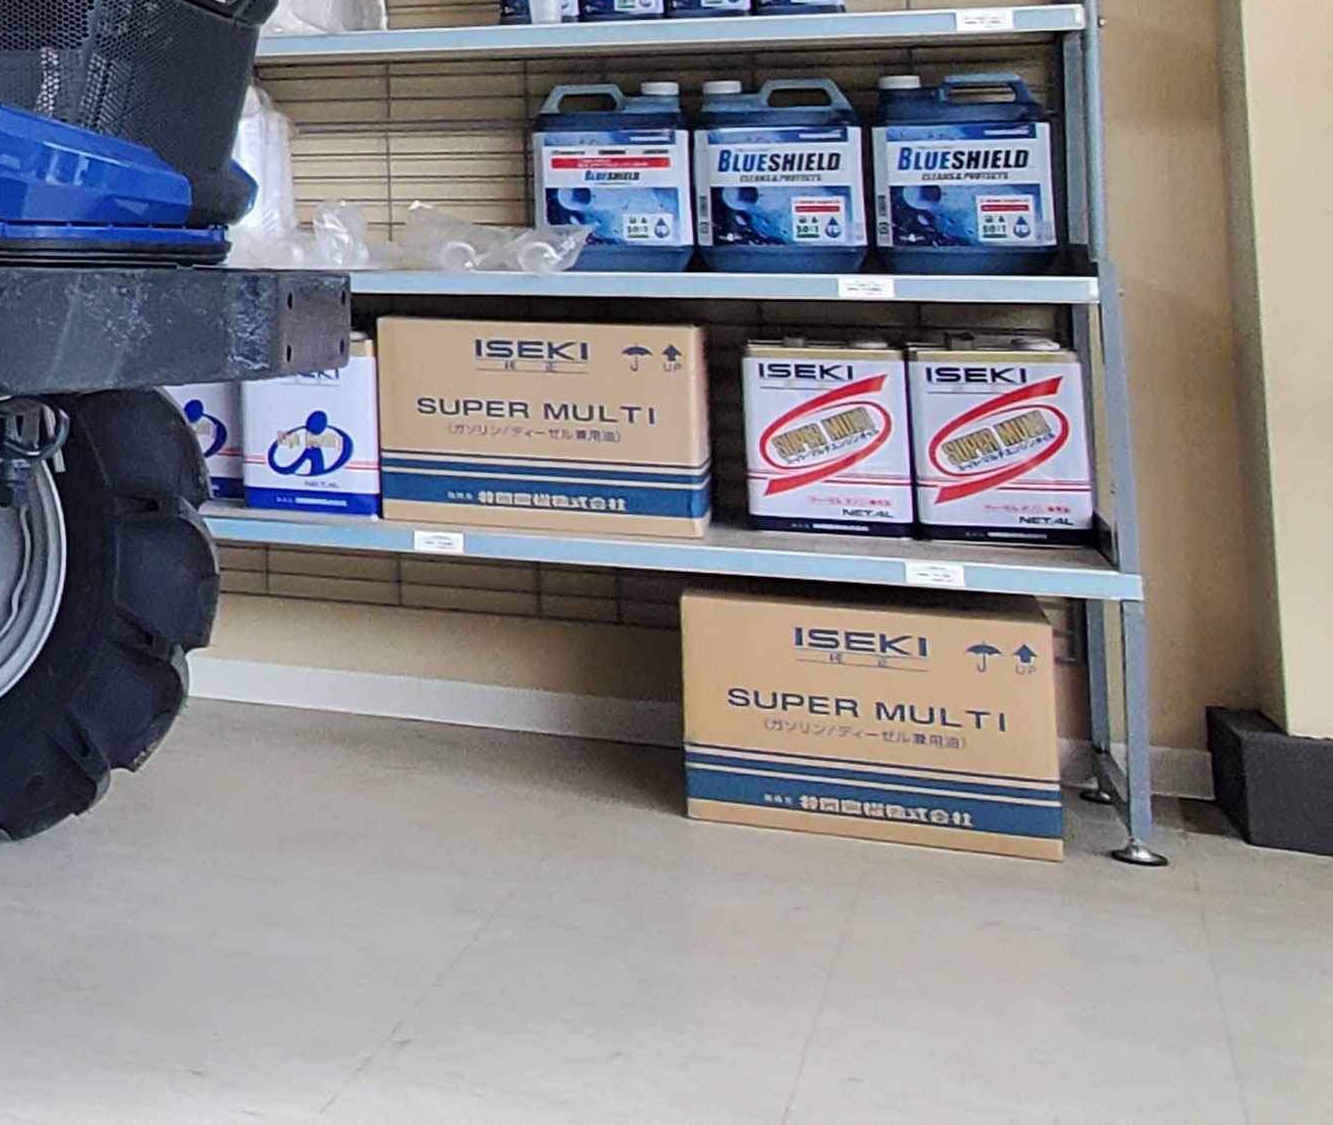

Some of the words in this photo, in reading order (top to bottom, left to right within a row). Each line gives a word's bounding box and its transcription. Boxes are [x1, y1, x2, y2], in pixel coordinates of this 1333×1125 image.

[718, 149, 841, 173] BLUESHIELD
[897, 147, 1030, 171] BLUESHIELD
[474, 338, 589, 361] ISEKI
[662, 362, 683, 373] UP
[758, 362, 855, 381] ISEKI
[925, 366, 1028, 384] ISEKI
[416, 396, 530, 420] SUPER
[542, 402, 657, 426] MULTI
[770, 422, 828, 460] SUPER
[940, 426, 1000, 466] SUPER
[794, 626, 929, 659] ISEKI
[1015, 663, 1038, 676] UP
[727, 687, 861, 720] SUPER
[874, 701, 1008, 733] MULTI
